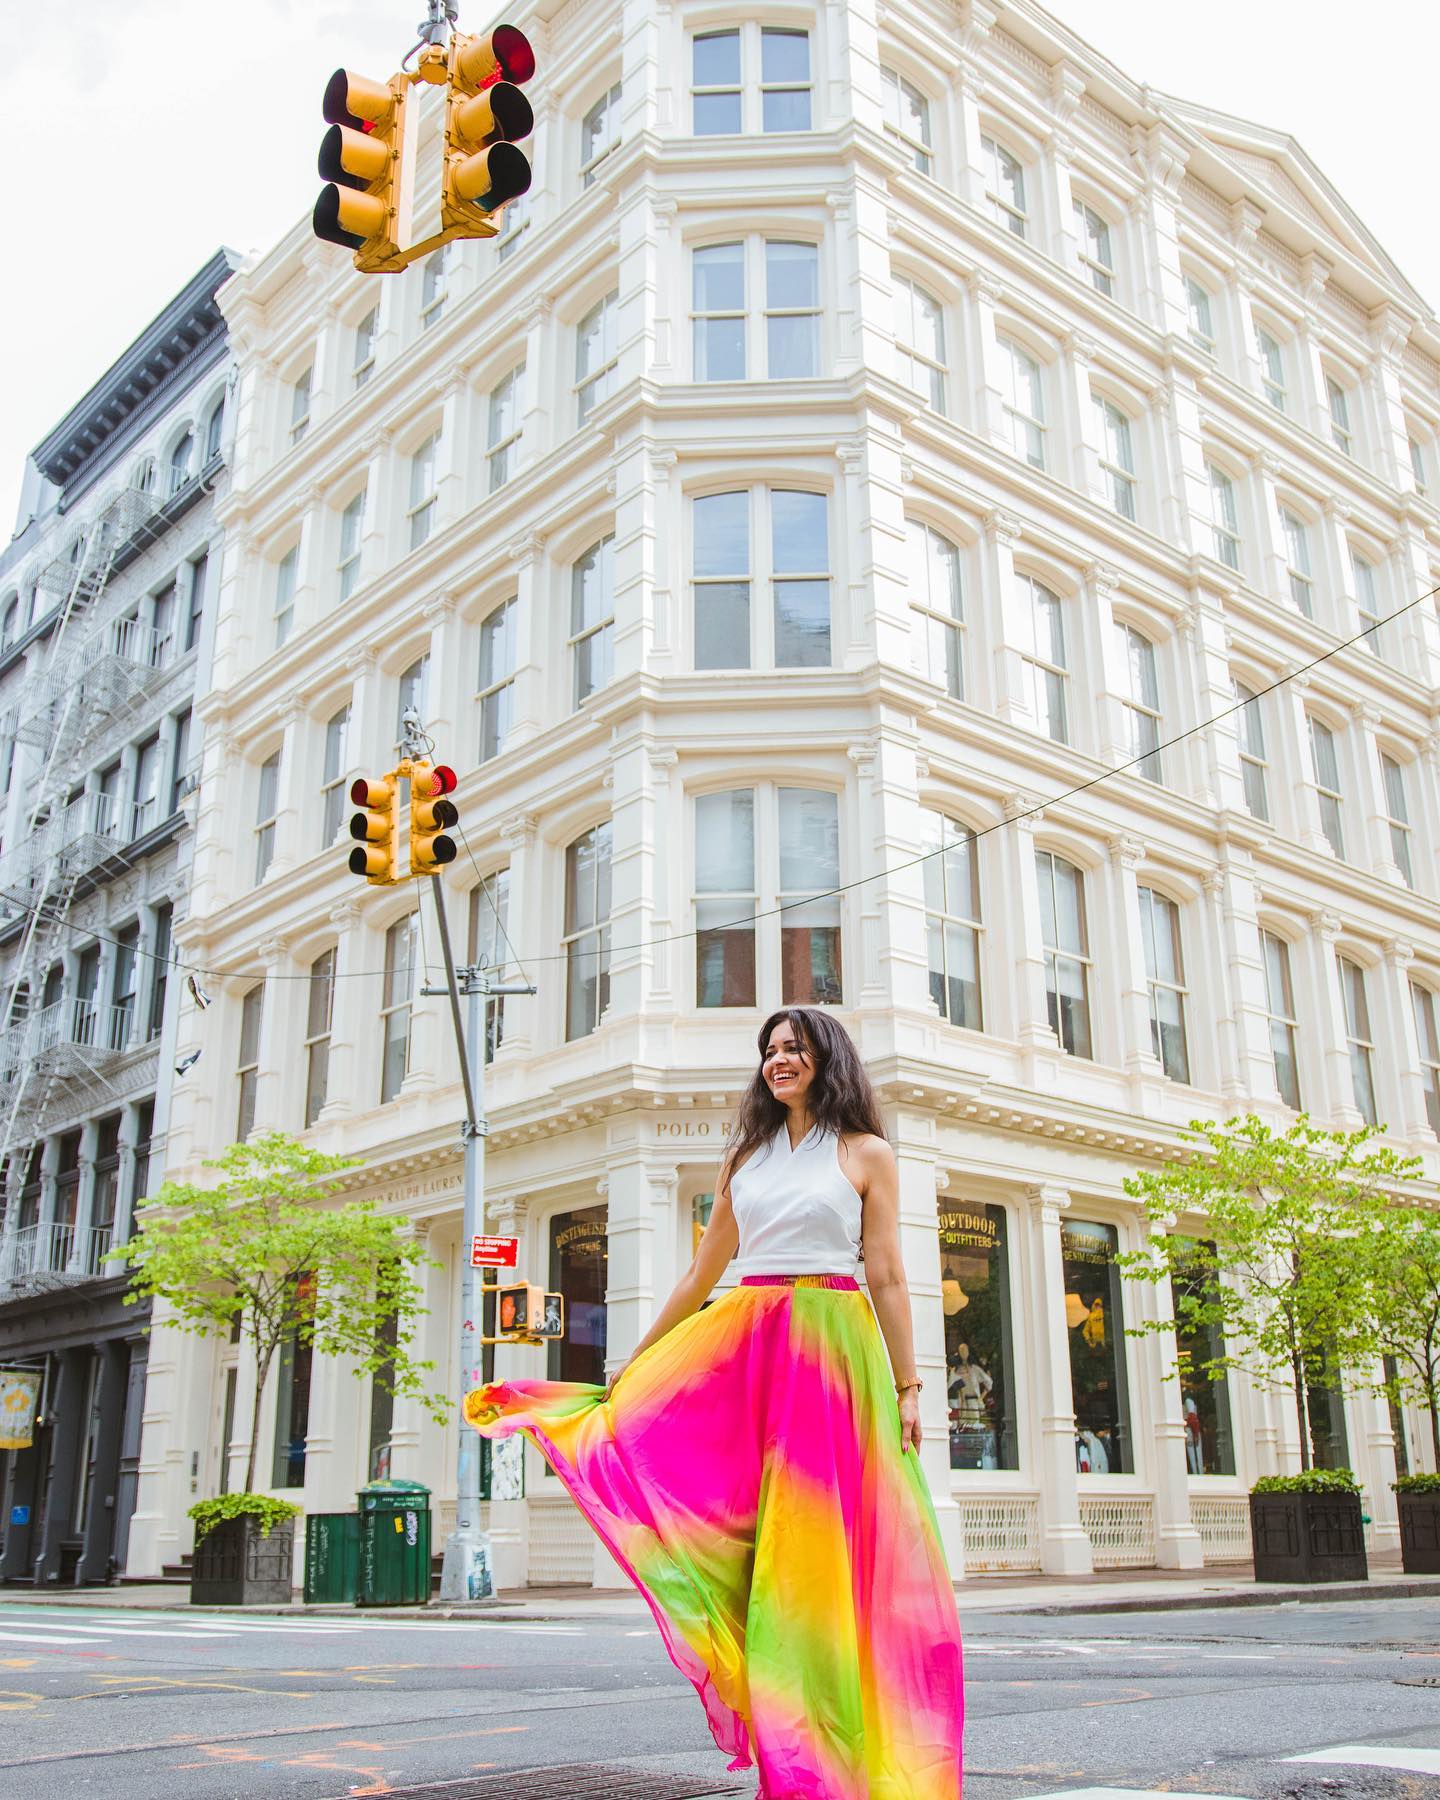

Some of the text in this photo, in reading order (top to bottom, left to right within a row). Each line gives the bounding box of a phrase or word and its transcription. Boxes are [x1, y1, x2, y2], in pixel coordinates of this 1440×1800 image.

[656, 1121, 710, 1136] POLO
[387, 1185, 419, 1202] RALPH
[940, 1212, 996, 1237] OUTDOOR
[946, 1232, 993, 1248] OUTFITTERS
